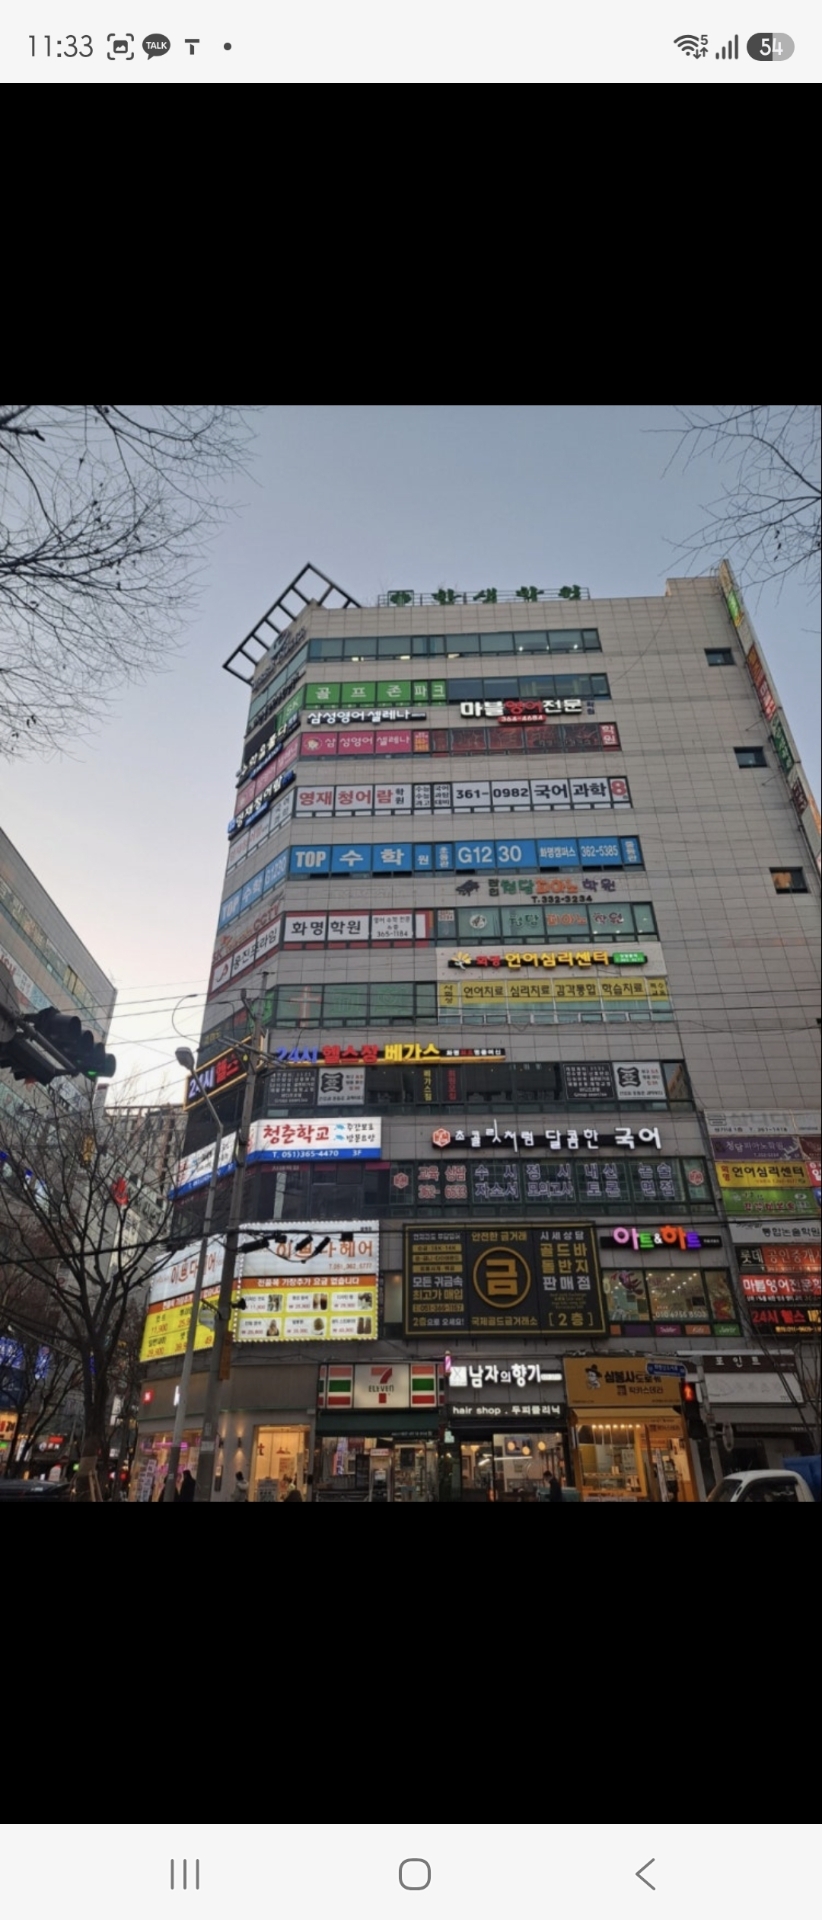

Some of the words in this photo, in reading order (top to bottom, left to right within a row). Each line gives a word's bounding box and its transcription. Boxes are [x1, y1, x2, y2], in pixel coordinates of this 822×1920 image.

[315, 684, 445, 700] 골프존파크
[460, 699, 582, 717] 마블영어전문
[308, 710, 364, 725] 삼성영어
[367, 709, 410, 723] 셀레나
[325, 736, 373, 748] 삼성영어
[299, 789, 393, 806] 영재청어람
[456, 787, 529, 799] 361-0982
[534, 784, 568, 798] 국어
[573, 782, 607, 798] 과학
[296, 851, 326, 868] TOP
[291, 920, 361, 936] 화명학원
[504, 951, 609, 969] 언어심리센터
[463, 986, 503, 999] 언어치료
[510, 984, 550, 998] 심리치료
[602, 982, 644, 996] 학습치료
[277, 1046, 317, 1063] 24시
[322, 1044, 379, 1064] 헬스장
[384, 1043, 441, 1061] 베가스
[263, 1123, 330, 1145] 청춘학교
[545, 1128, 599, 1150] 달콤한
[614, 1127, 662, 1149] 국어
[732, 1165, 805, 1178] 언어심리센터
[540, 1230, 585, 1241] 시세상담
[613, 1223, 702, 1251] 아트&하트
[540, 1242, 588, 1257] 골드바
[413, 1275, 432, 1288] 모든
[434, 1275, 463, 1288] 귀금속
[485, 1258, 518, 1296] 금
[542, 1275, 592, 1291] 판매점
[468, 1362, 542, 1389] 남자의향기
[452, 1405, 472, 1414] hair
[476, 1405, 501, 1416] shop
[511, 1405, 560, 1415] 두피클리닉
